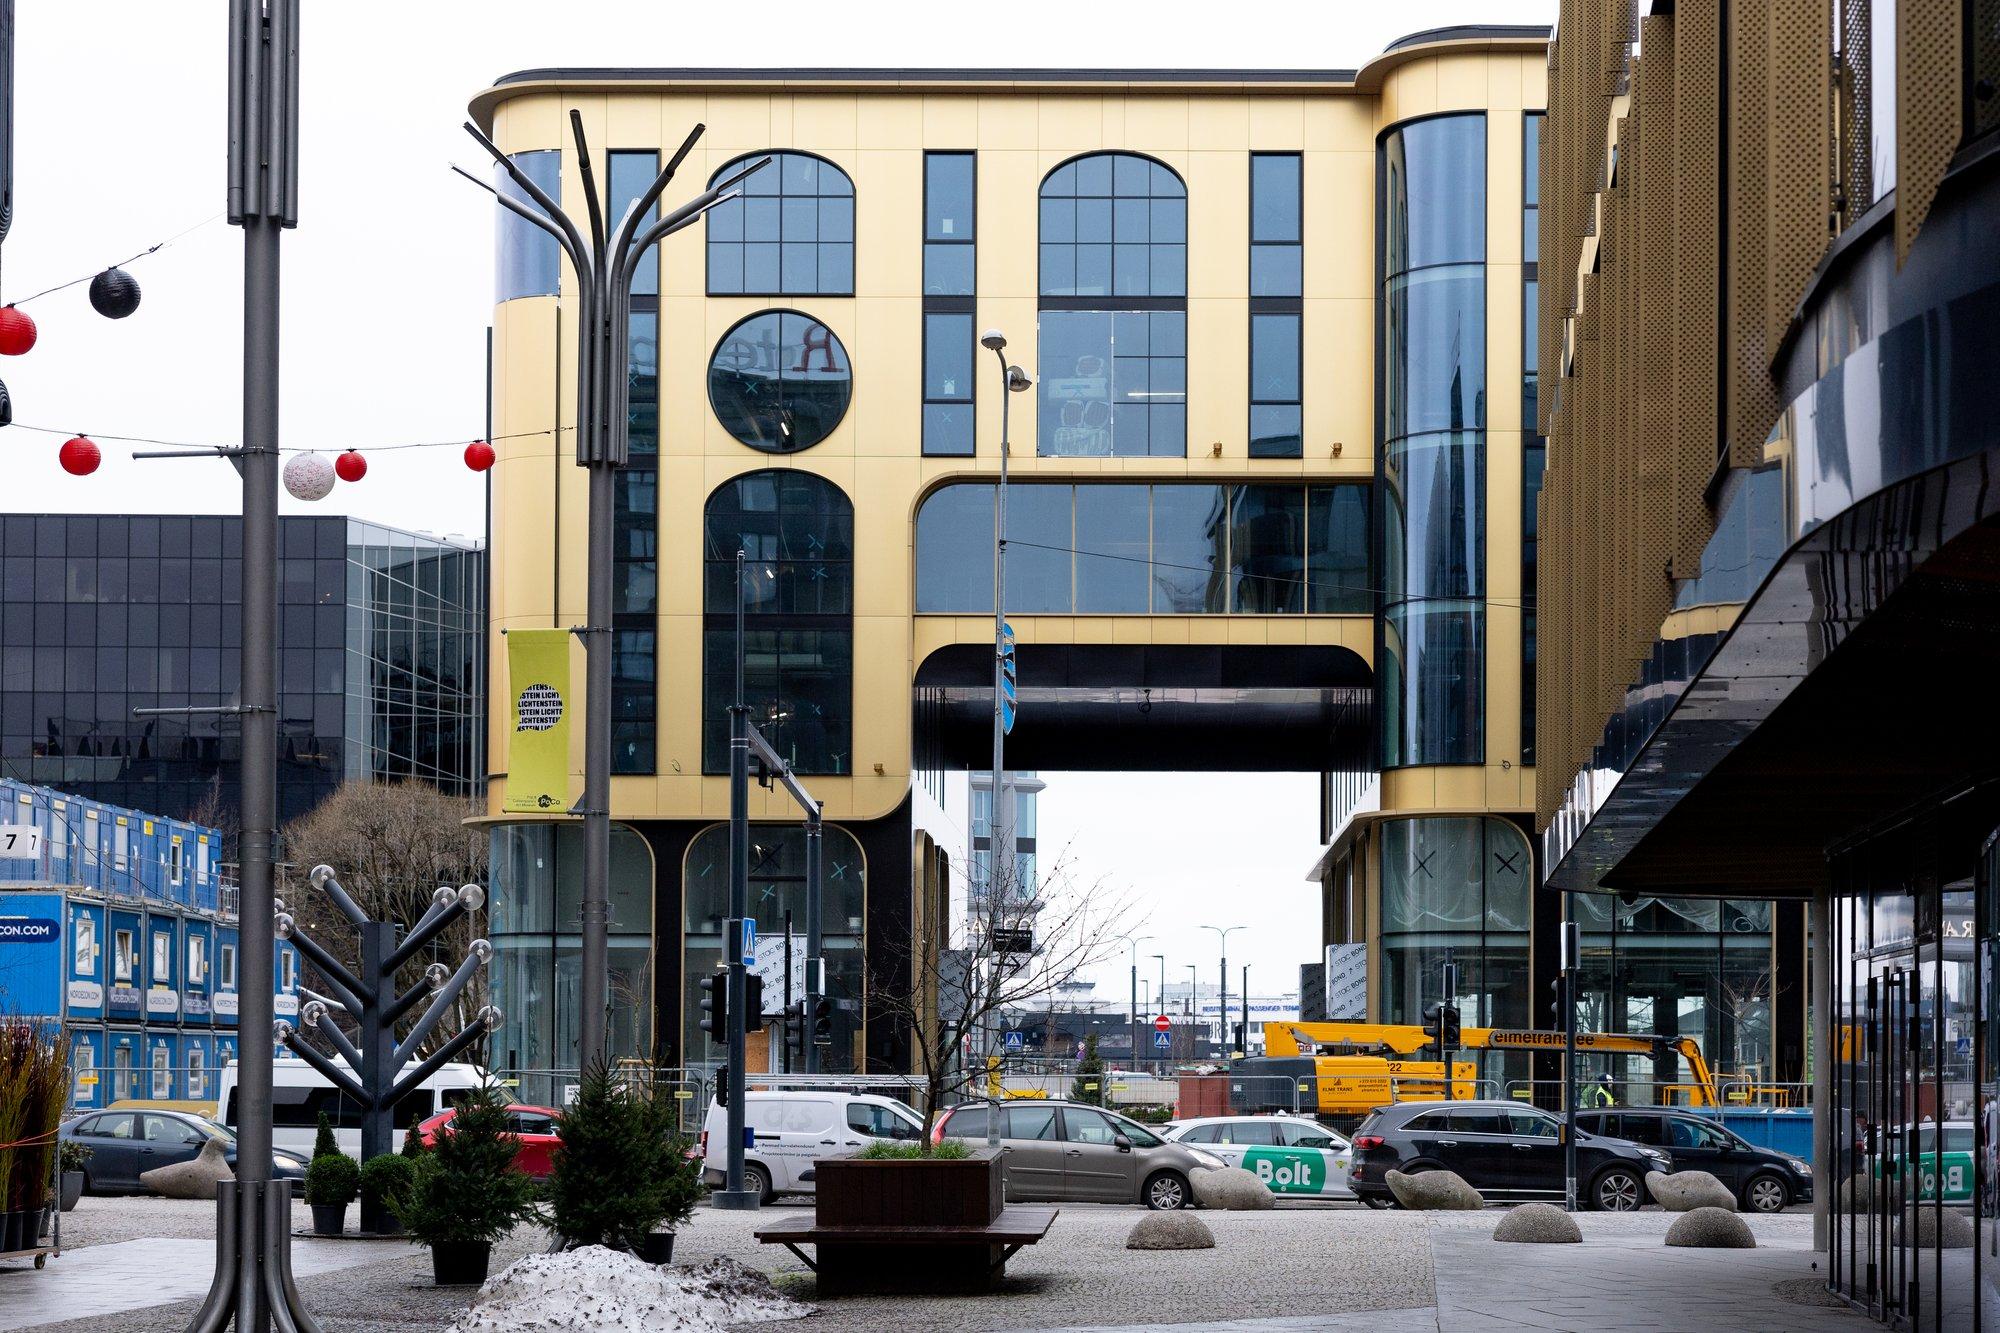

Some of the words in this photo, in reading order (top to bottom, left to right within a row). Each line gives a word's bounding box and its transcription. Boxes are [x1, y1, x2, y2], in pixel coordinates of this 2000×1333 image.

[6, 834, 17, 850] 7
[31, 834, 37, 850] 7
[1257, 1159, 1311, 1186] Bolt
